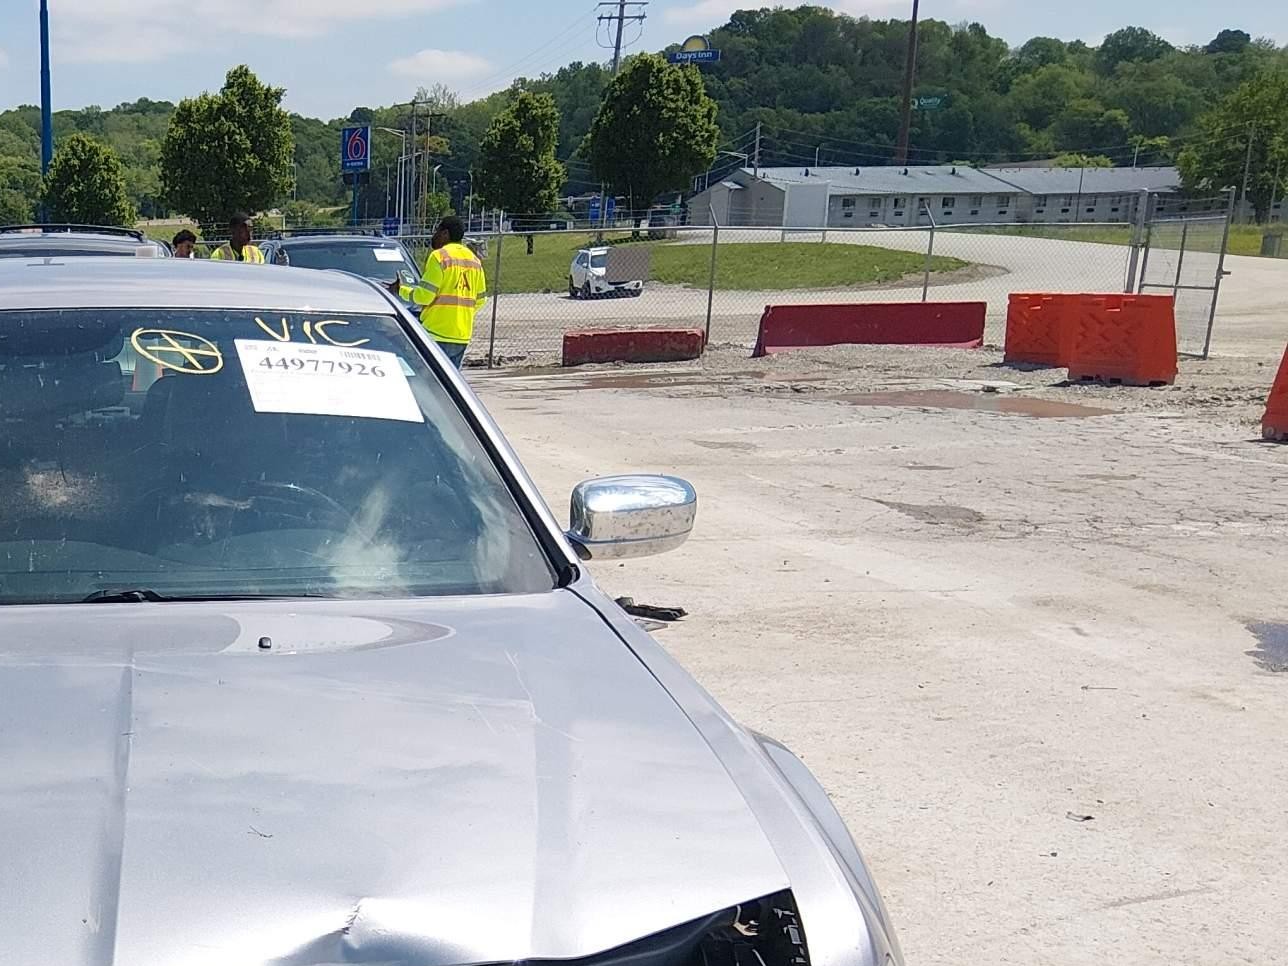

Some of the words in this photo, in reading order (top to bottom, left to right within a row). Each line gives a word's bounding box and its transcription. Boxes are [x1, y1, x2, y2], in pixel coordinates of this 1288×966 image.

[675, 52, 697, 60] Days
[347, 127, 366, 160] 6
[254, 316, 371, 347] VIC
[258, 356, 386, 378] 44977926
